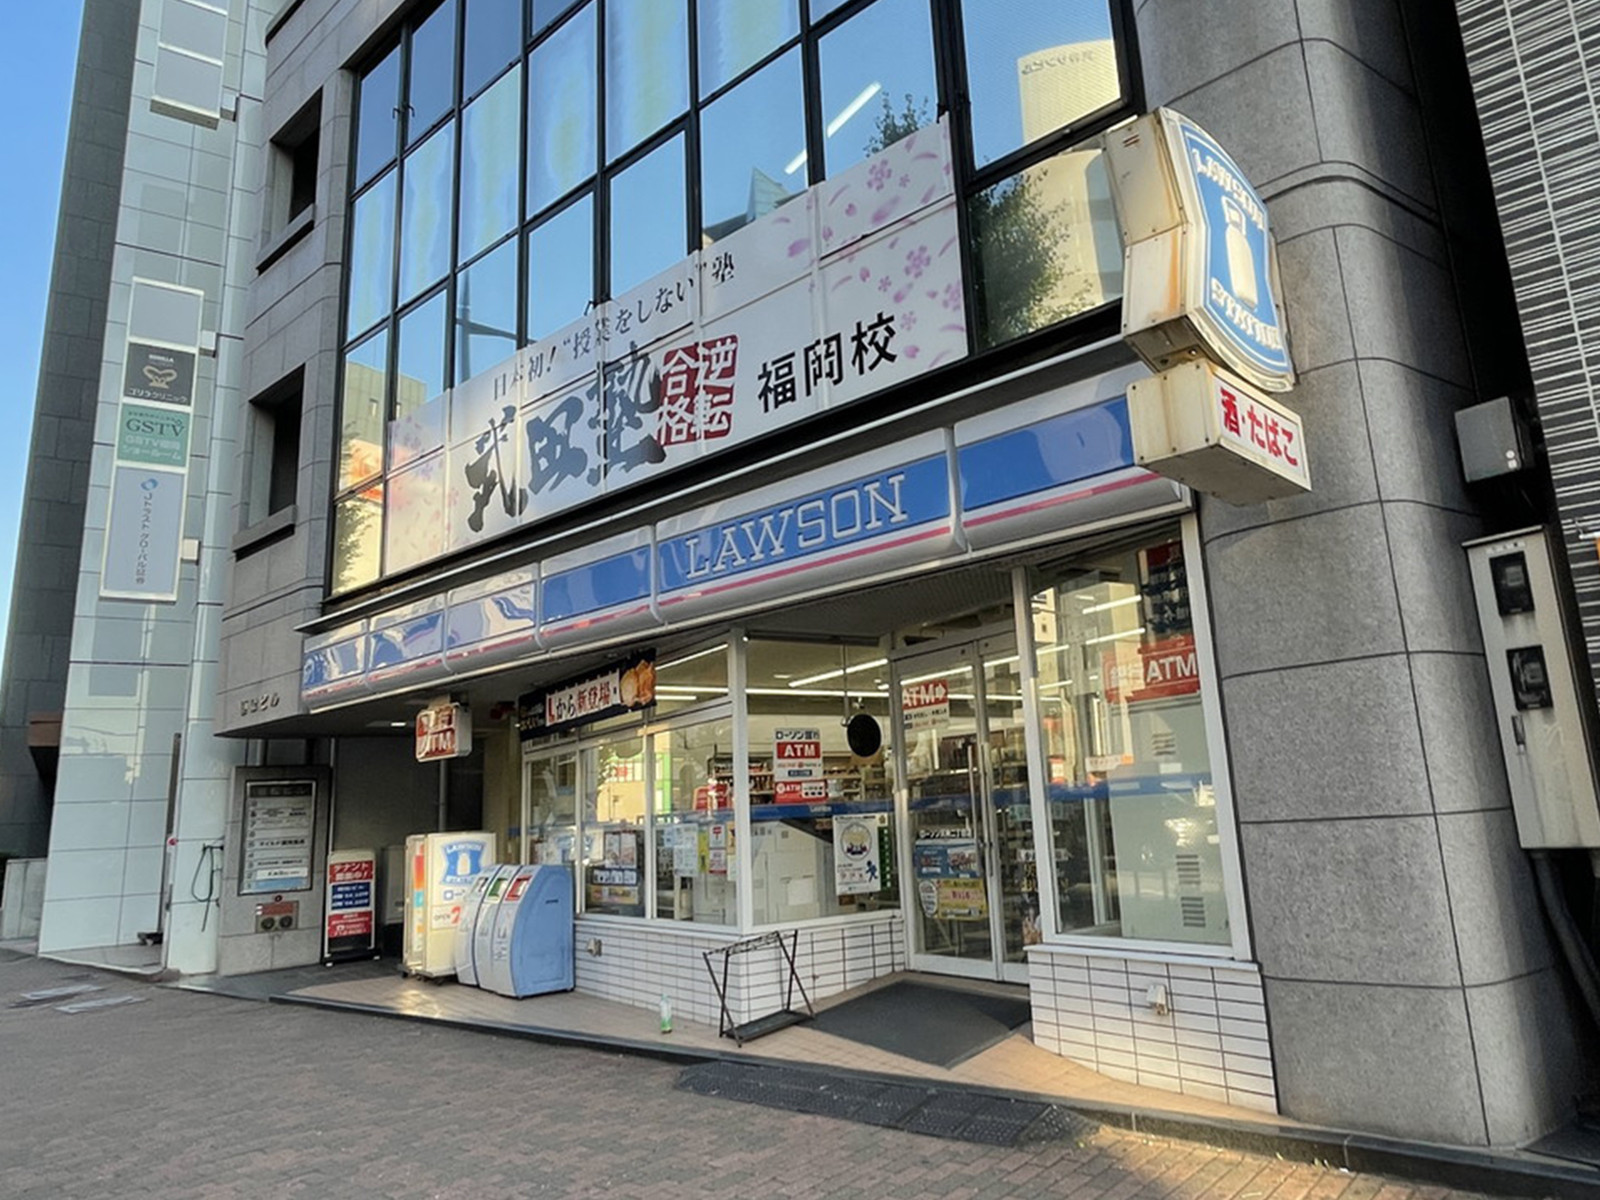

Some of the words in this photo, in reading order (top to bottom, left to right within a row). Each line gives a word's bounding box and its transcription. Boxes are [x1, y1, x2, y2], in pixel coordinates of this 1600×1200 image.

[757, 312, 899, 414] 福岡校
[126, 418, 185, 437] GSTV
[464, 340, 667, 533] 武田塾
[685, 472, 909, 580] LAWSON
[1145, 652, 1197, 684] ATM
[784, 743, 816, 758] ATM
